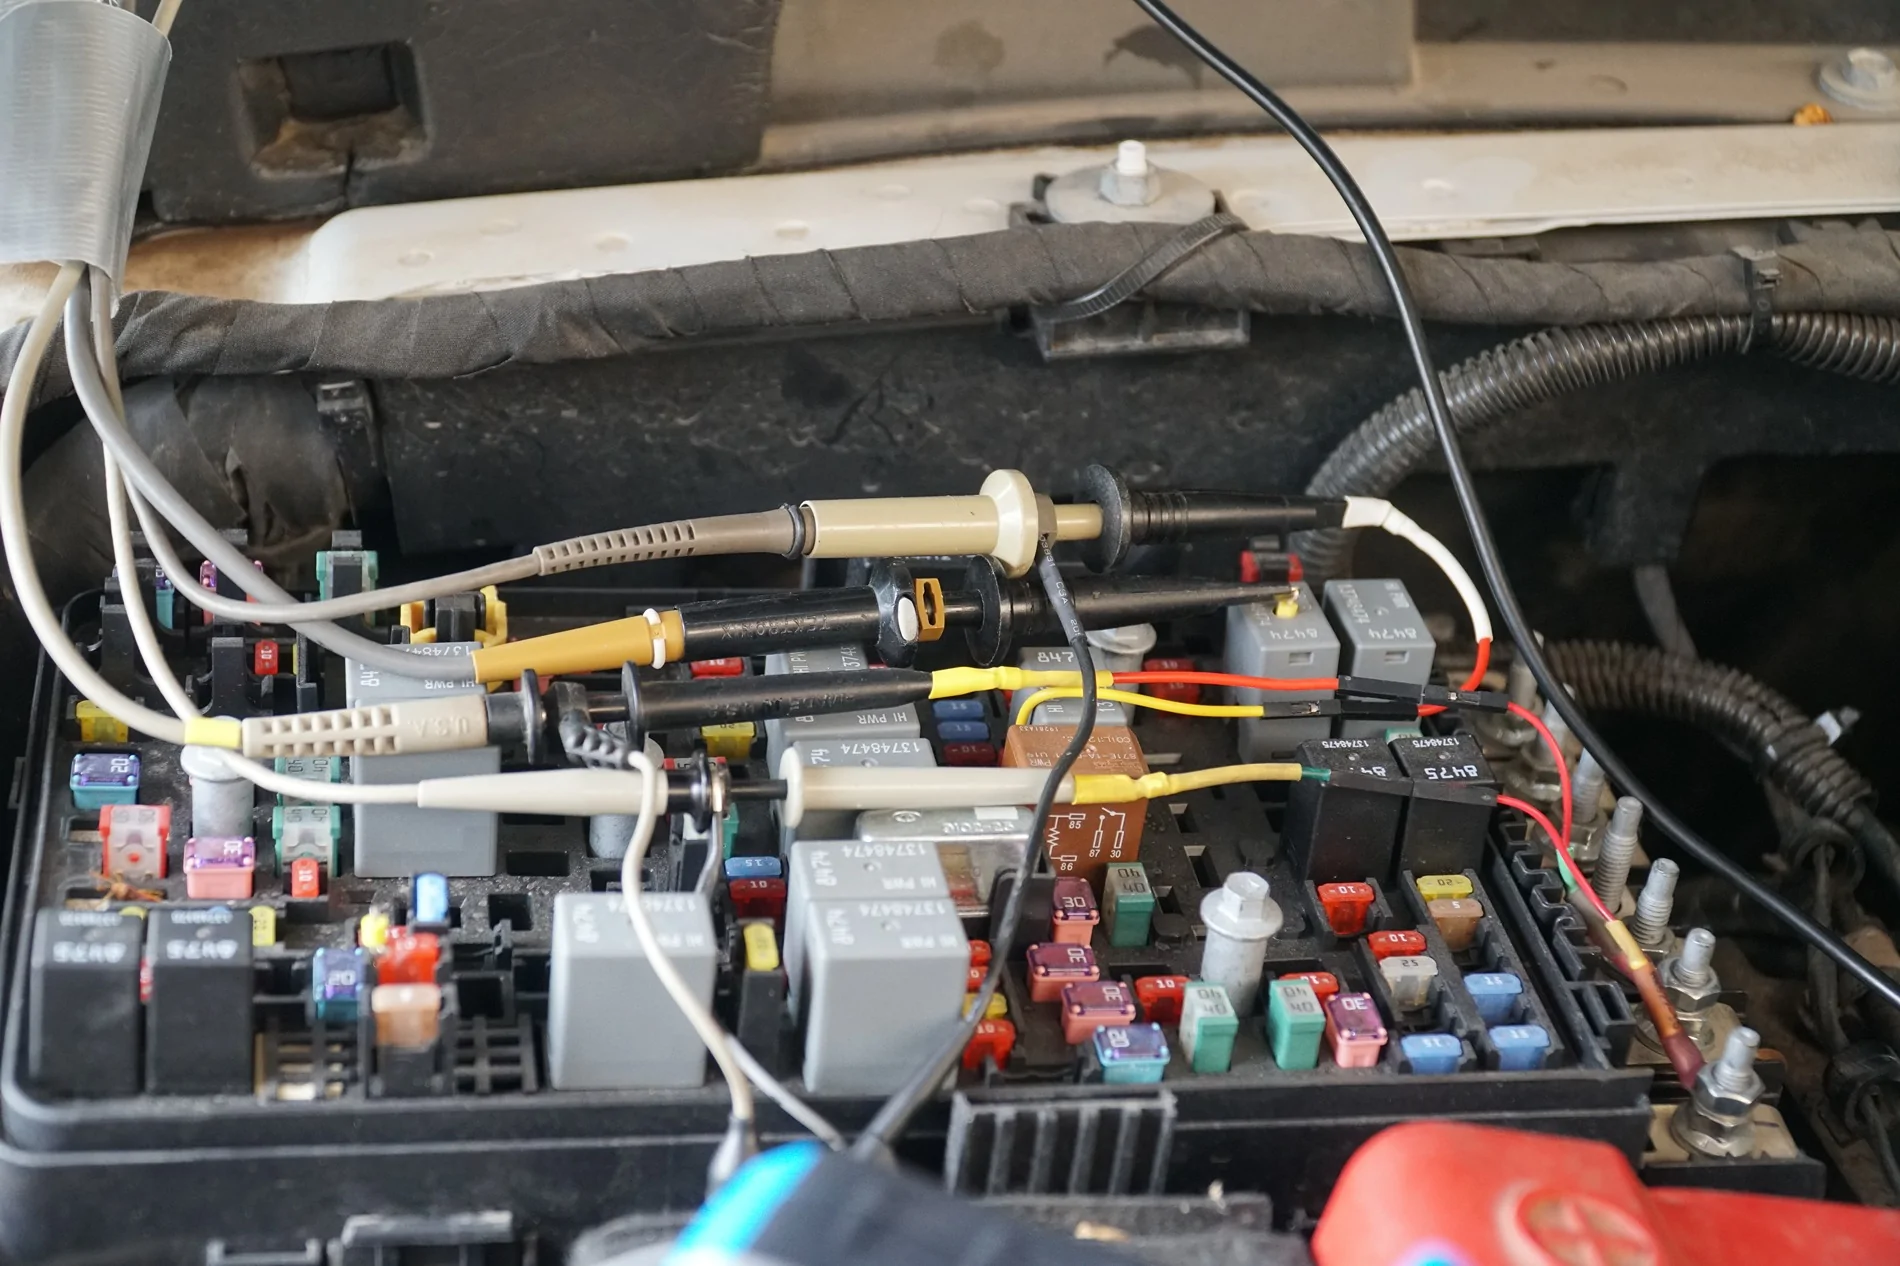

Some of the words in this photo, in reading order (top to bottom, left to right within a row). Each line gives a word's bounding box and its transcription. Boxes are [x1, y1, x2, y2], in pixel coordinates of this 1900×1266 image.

[1056, 582, 1068, 605] CSA
[1368, 628, 1418, 640] 8474
[360, 663, 380, 687] 84
[425, 679, 454, 690] PWR
[857, 713, 887, 725] PWR
[892, 712, 907, 722] HI
[840, 742, 920, 755] 13748474
[1321, 740, 1370, 749] 13748475
[1412, 738, 1460, 748] 13748475
[111, 758, 129, 772] 20
[1029, 758, 1052, 767] PWR
[1424, 764, 1478, 780] 8475
[1068, 820, 1082, 829] 85
[842, 843, 926, 858] 13748474
[1088, 849, 1101, 858] 87
[1110, 849, 1122, 859] 30
[745, 859, 763, 868] 15
[1060, 862, 1074, 871] 86
[1118, 868, 1141, 879] 40
[750, 880, 768, 889] 10
[881, 876, 915, 890] PWR
[1124, 881, 1146, 893] 40
[1437, 878, 1454, 887] 20
[1338, 885, 1356, 894] 10
[1061, 896, 1087, 908] 30
[857, 902, 946, 918] 13748474
[1388, 933, 1408, 943] 10
[1067, 947, 1087, 964] 30
[1156, 979, 1176, 989] 10
[1483, 975, 1503, 986] 15
[1102, 985, 1124, 1003] 30
[1342, 997, 1369, 1011] 30
[1108, 1027, 1131, 1048] 20
